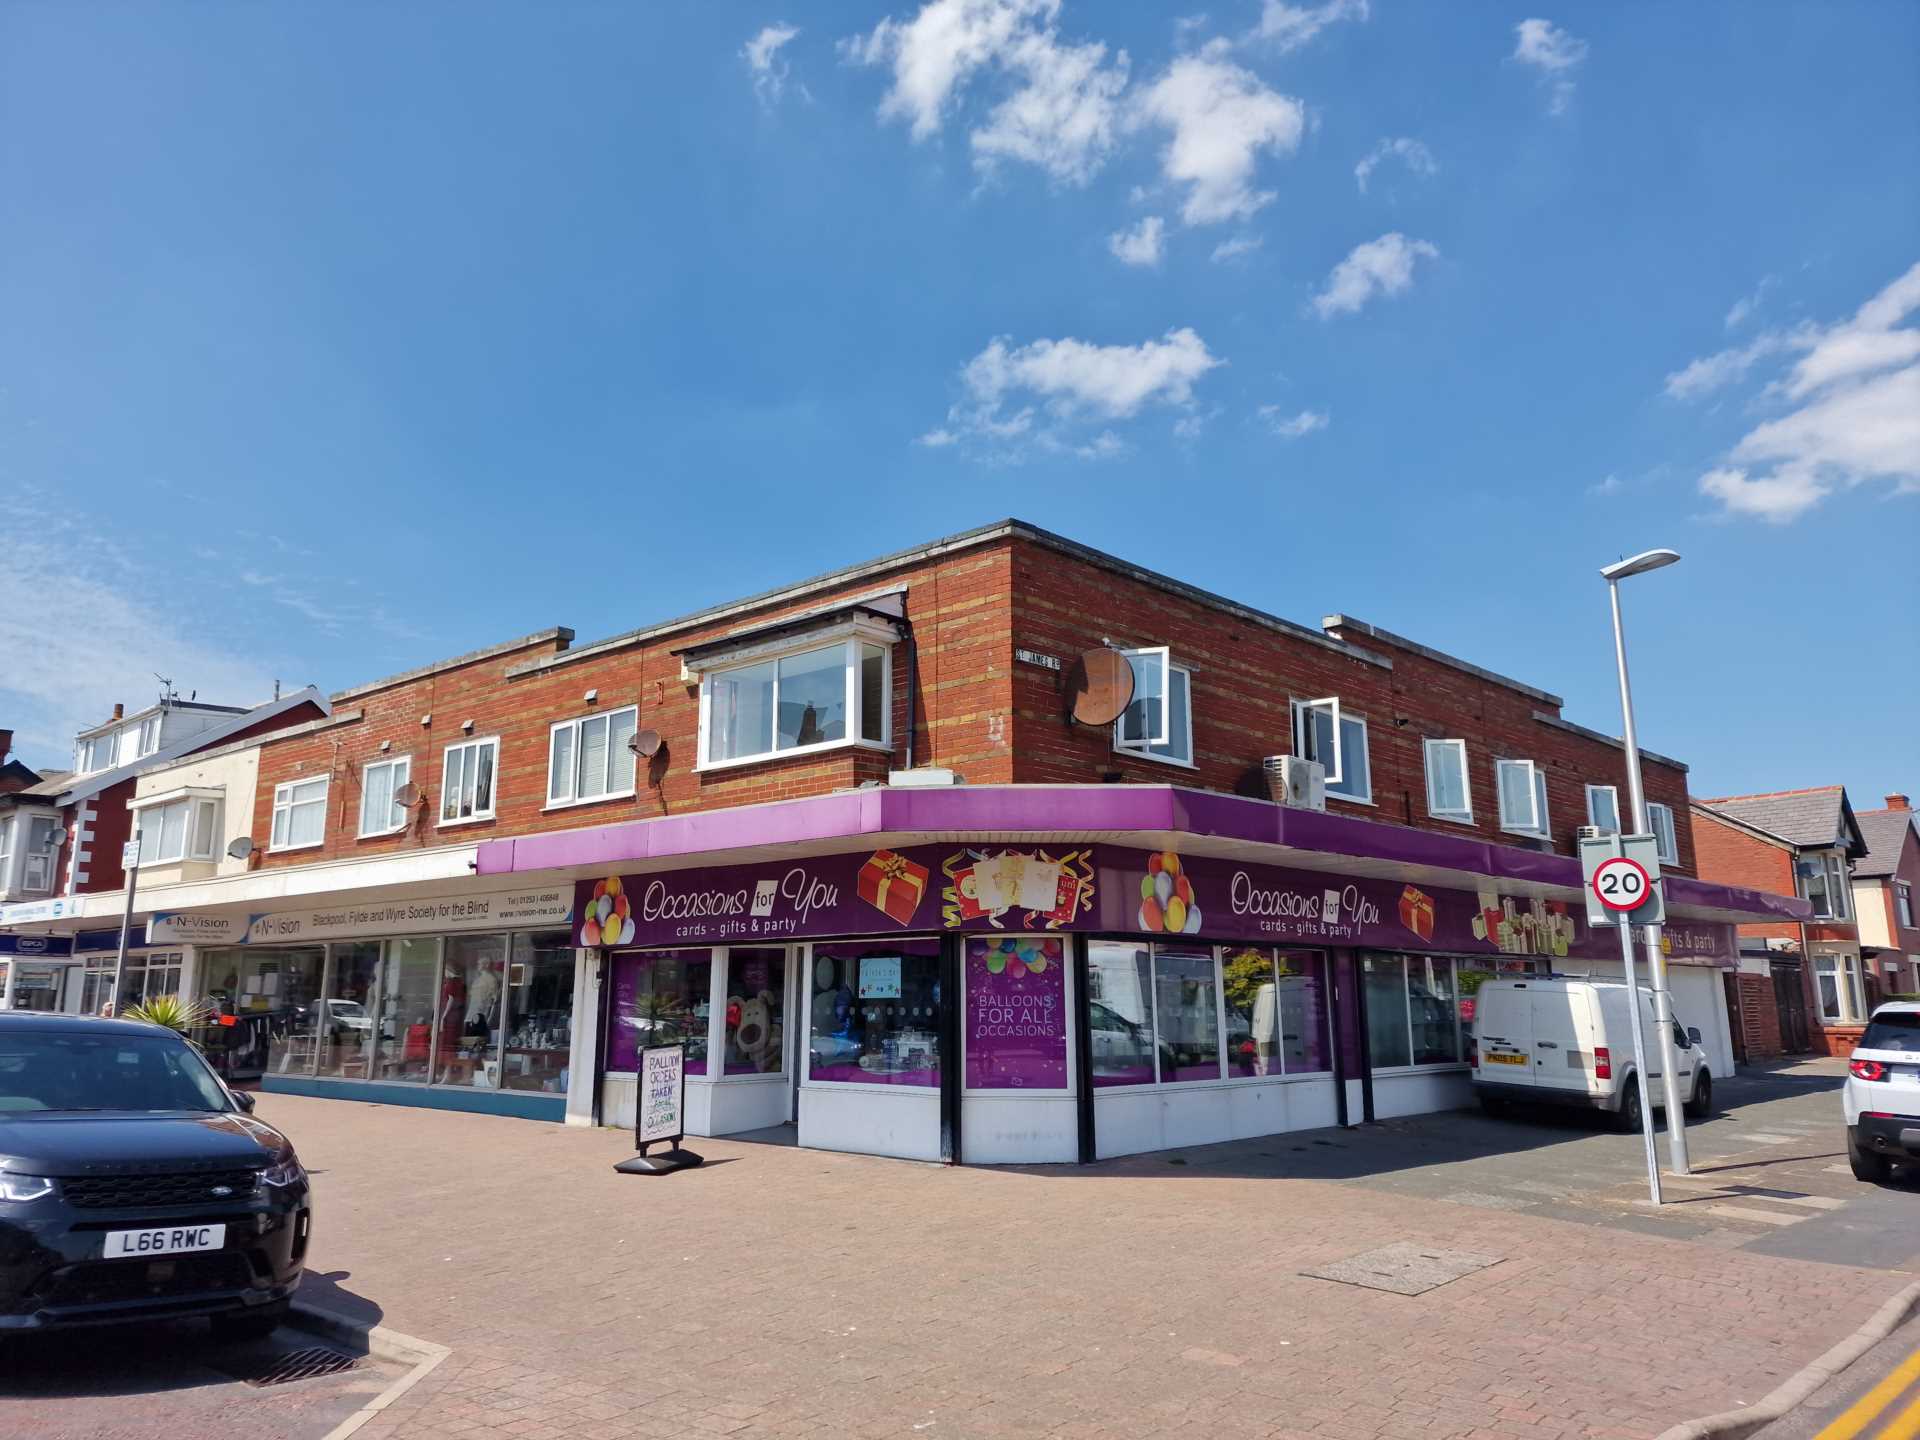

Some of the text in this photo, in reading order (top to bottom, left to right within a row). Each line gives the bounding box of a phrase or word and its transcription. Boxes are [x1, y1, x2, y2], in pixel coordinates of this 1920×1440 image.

[1602, 873, 1641, 894] 20
[643, 868, 838, 924] Occasions for You
[1231, 871, 1380, 935] Occasions for You
[176, 914, 230, 929] N-Vision
[349, 909, 368, 926] Fylde
[371, 907, 384, 921] and
[386, 905, 406, 923] Wyre
[408, 903, 437, 920] Society
[439, 902, 450, 917] for
[452, 901, 465, 916] the
[467, 900, 489, 915] Blind
[676, 922, 707, 937] cards
[719, 919, 746, 937] gifts
[751, 919, 759, 932] &
[764, 917, 797, 934] party
[1260, 919, 1287, 932] cards
[1297, 921, 1318, 936] gifts
[1320, 922, 1327, 935] &
[1330, 924, 1352, 940] party
[1694, 932, 1716, 953] party
[979, 994, 1053, 1007] BALLOONS
[978, 1007, 1053, 1024] FOR ALL
[977, 1024, 1055, 1037] OCCASIONS
[650, 1085, 673, 1099] TAKEN
[122, 1228, 210, 1252] L66 RWC
